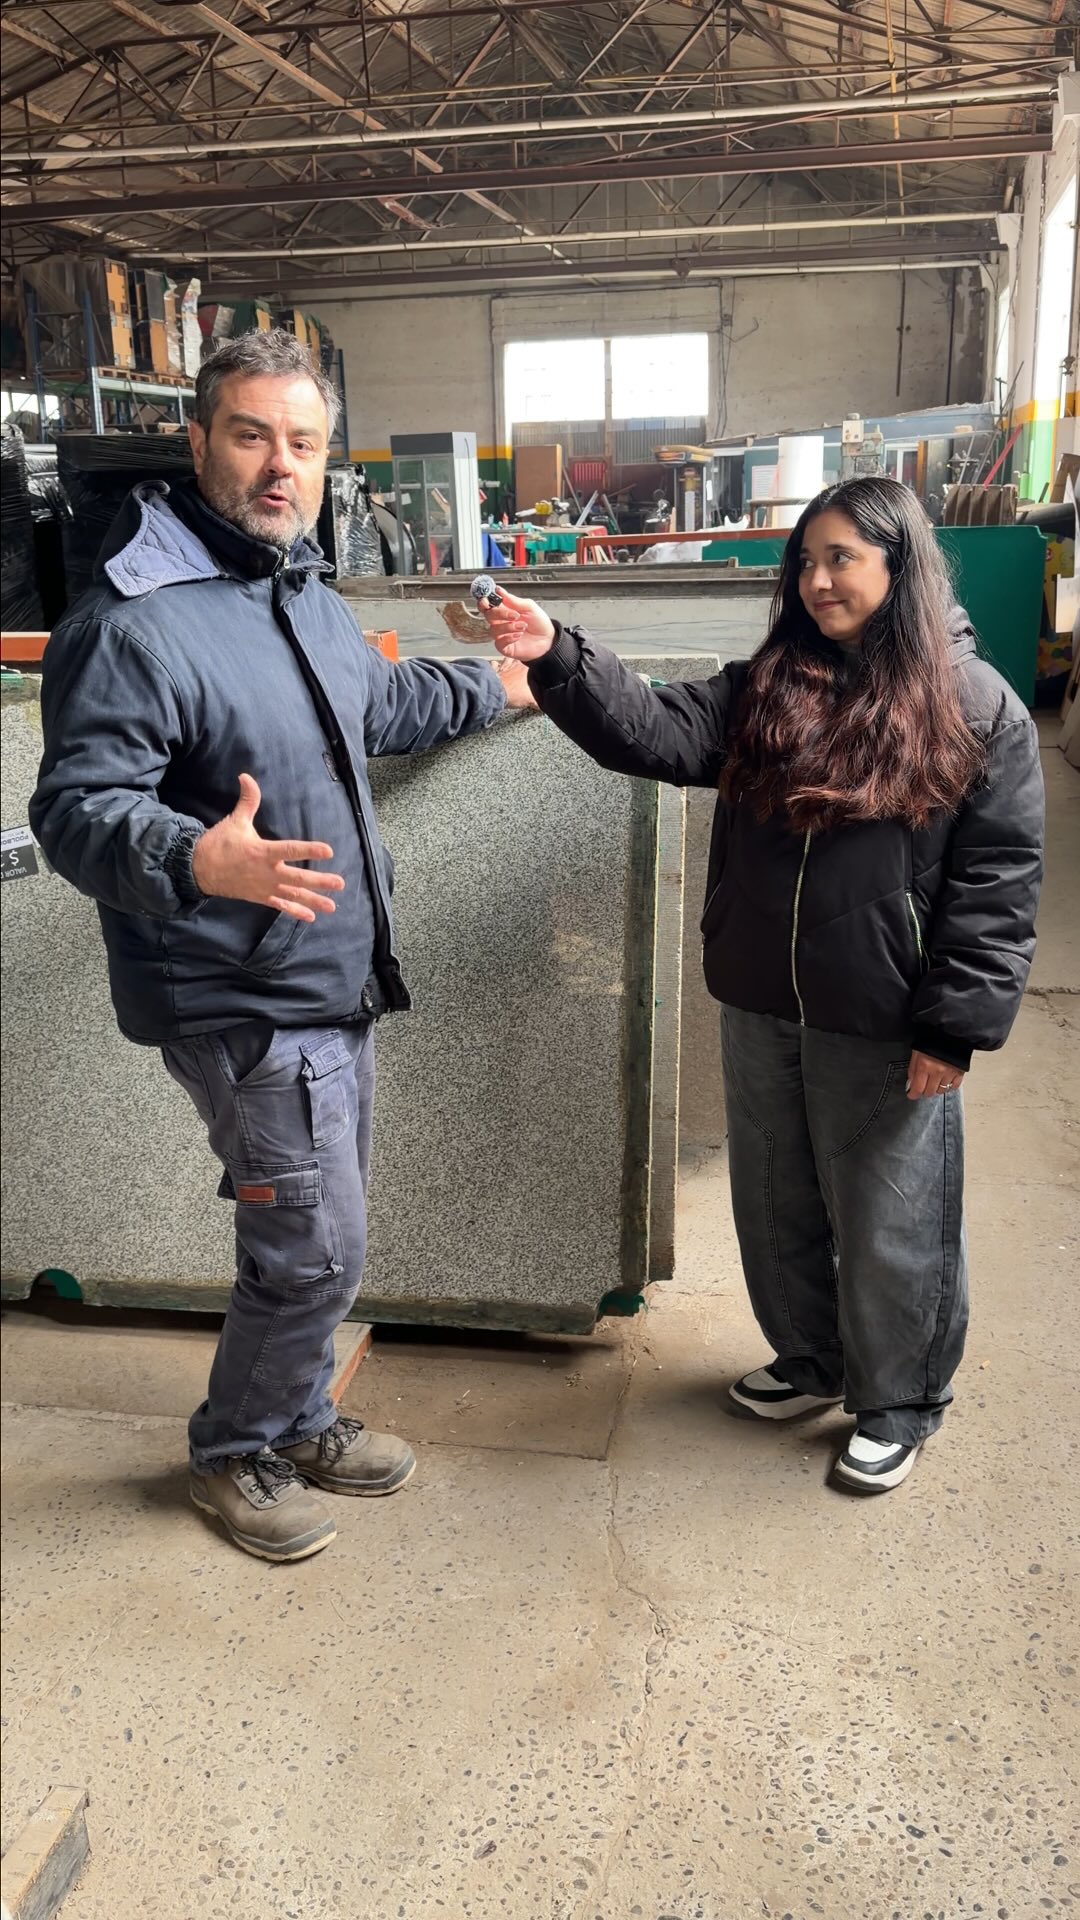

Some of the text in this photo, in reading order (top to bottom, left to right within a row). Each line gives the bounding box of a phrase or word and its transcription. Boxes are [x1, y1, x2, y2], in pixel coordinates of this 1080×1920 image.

[1, 834, 28, 845] POOLBO
[9, 849, 20, 866] $
[5, 866, 27, 877] VALOR
